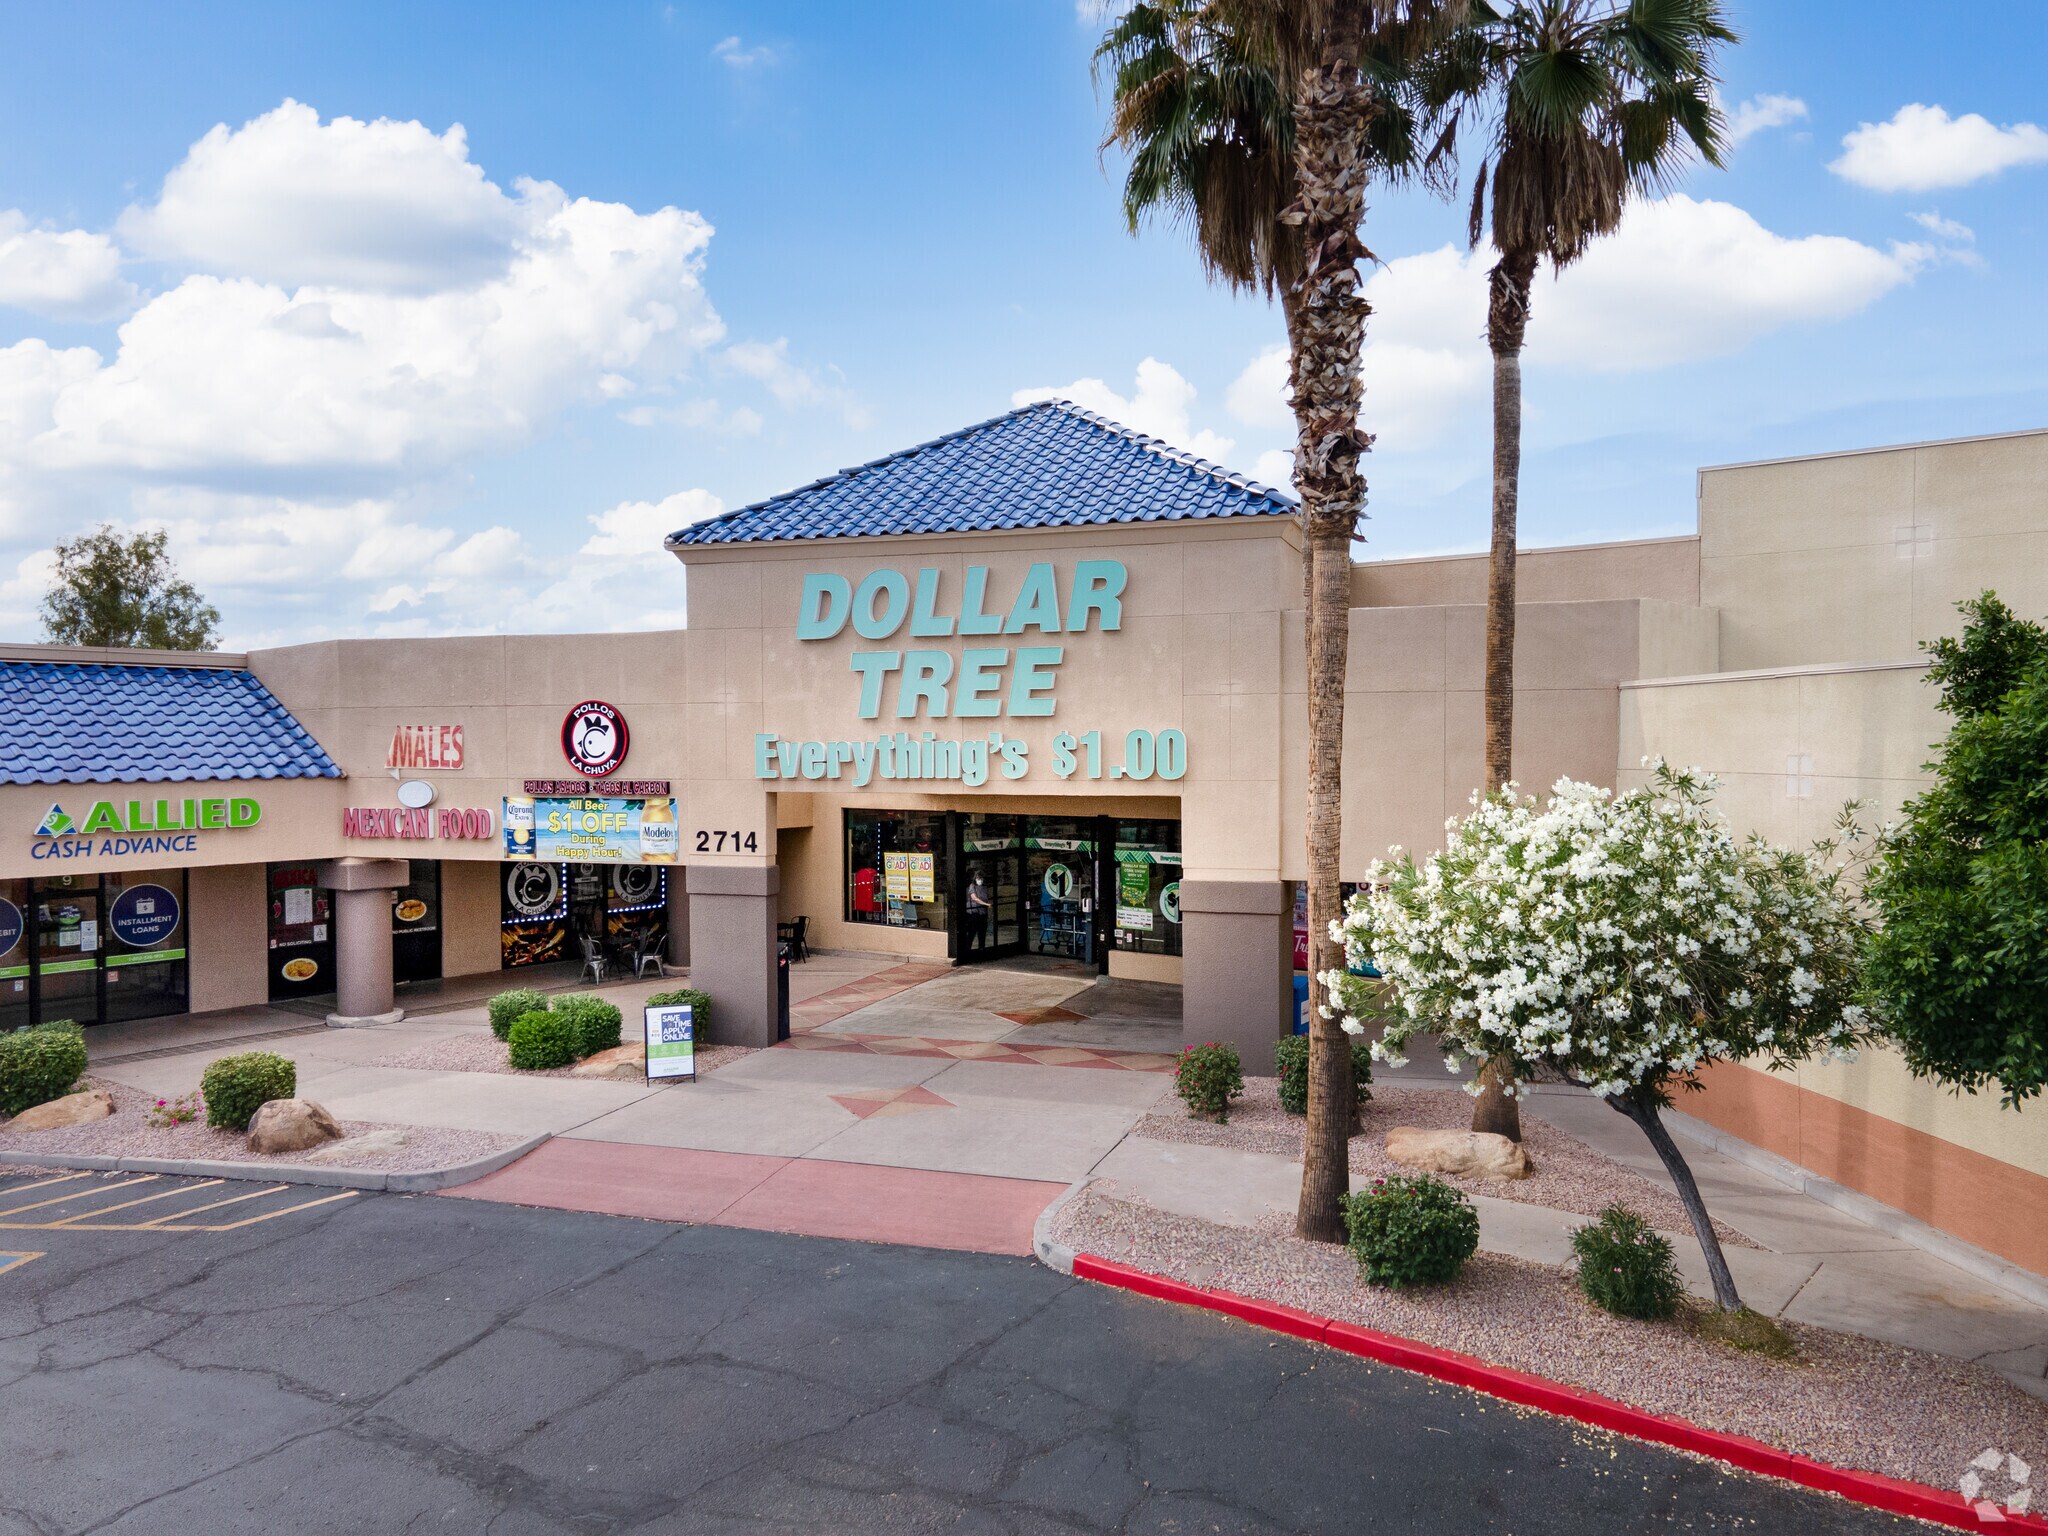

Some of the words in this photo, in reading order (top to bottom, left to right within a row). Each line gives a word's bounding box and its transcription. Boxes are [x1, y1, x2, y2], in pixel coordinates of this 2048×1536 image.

[796, 559, 1129, 641] DOLLAR
[850, 646, 1065, 720] TREE
[573, 703, 615, 720] POLLOS
[386, 725, 463, 768] MALES
[754, 731, 1030, 787] Everything's
[1051, 728, 1189, 780] $1.00
[570, 756, 582, 771] LA
[583, 758, 617, 775] CHUYA
[524, 781, 554, 795] POLLOS
[555, 781, 588, 795] ASADOS
[594, 781, 620, 795] TACOS
[621, 781, 632, 795] AL
[633, 781, 669, 795] CARBON
[568, 799, 582, 811] All
[584, 799, 609, 811] Beer
[79, 797, 262, 834] ALLIED
[548, 810, 572, 834] $1
[581, 812, 628, 833] OFF
[343, 808, 434, 839] MEXICAN
[438, 808, 494, 839] FOOD
[644, 826, 671, 838] Modelo
[31, 840, 93, 860] CASH
[99, 835, 198, 856] ADVANCE
[571, 834, 606, 846] During
[696, 830, 758, 852] 2714
[556, 847, 590, 859] Happy
[592, 847, 622, 857] Hour!
[62, 875, 72, 886] 9
[514, 902, 524, 912] LA
[525, 900, 551, 915] CHUYA
[118, 915, 173, 926] INSTALLMENT
[132, 925, 160, 934] LOANS
[662, 1014, 681, 1022] SAVE
[673, 1020, 692, 1028] TIME
[663, 1033, 691, 1041] ONLINE
